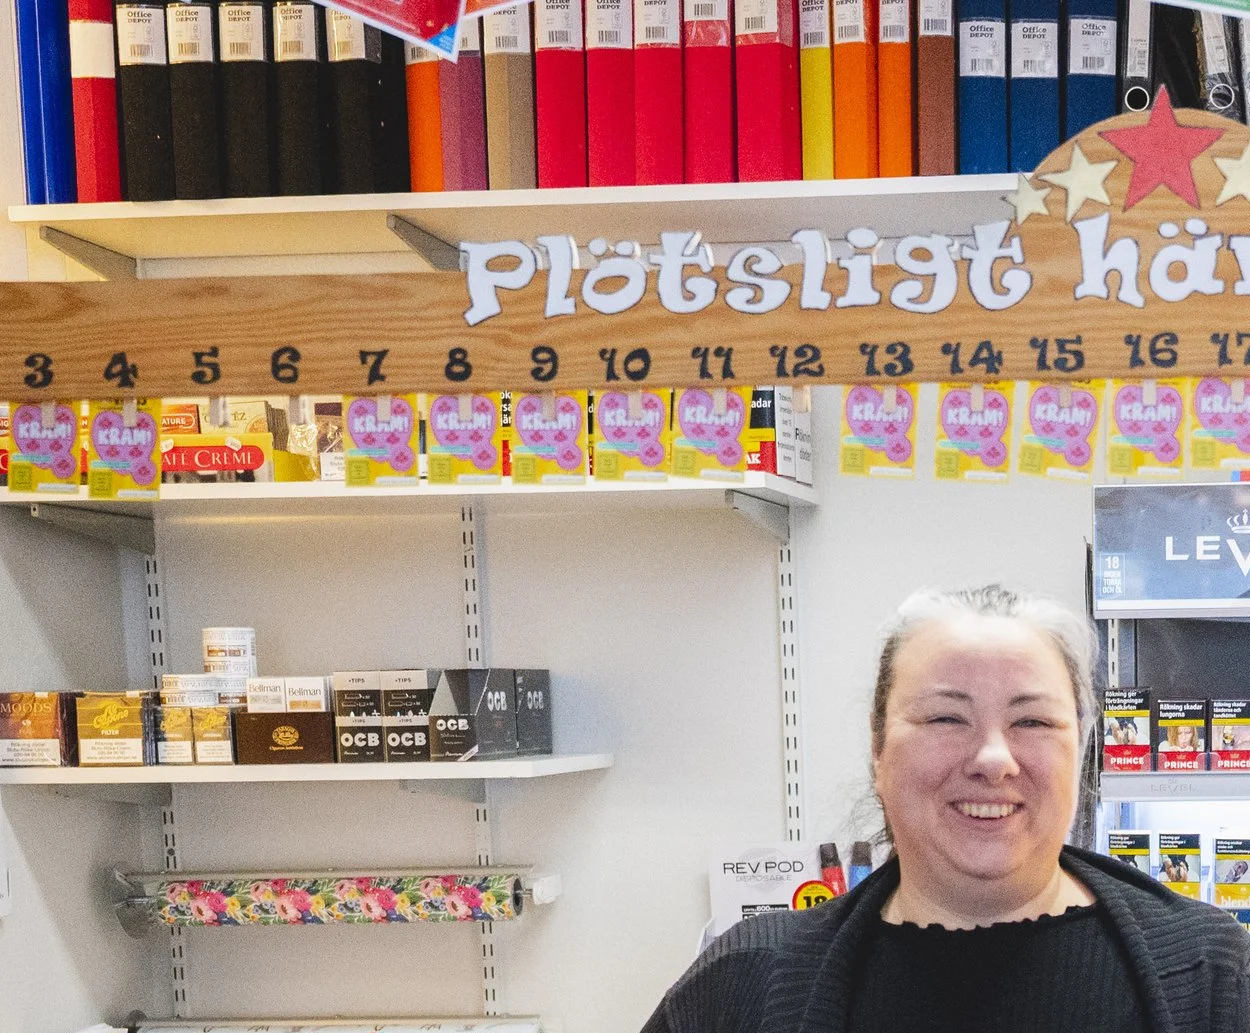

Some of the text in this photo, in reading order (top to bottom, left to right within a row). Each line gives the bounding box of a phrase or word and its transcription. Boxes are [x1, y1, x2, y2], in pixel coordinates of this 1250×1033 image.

[969, 25, 995, 33] Office
[1022, 26, 1047, 34] Office
[1081, 23, 1106, 31] Office
[24, 353, 54, 389] 3
[103, 352, 138, 388] 4
[191, 347, 220, 384] 5
[272, 346, 300, 383] 6
[360, 350, 388, 385] 7
[445, 348, 472, 381] 8
[531, 346, 558, 381] 9
[600, 348, 650, 381] 10
[692, 347, 734, 379] 11
[770, 344, 824, 377] 12
[860, 343, 913, 376] 13
[942, 342, 1002, 374] 14
[1031, 337, 1083, 371] 15
[1126, 333, 1177, 366] 16
[194, 449, 255, 468] CRÈME
[1105, 556, 1120, 569] 18
[249, 683, 282, 693] Bellman
[288, 687, 322, 697] Bellman
[487, 691, 507, 711] OCB
[436, 718, 469, 731] OCB
[341, 733, 380, 748] OCB
[387, 733, 427, 747] OCB
[1110, 756, 1144, 765] PRINCE
[1164, 761, 1198, 769] PRINCE
[723, 861, 804, 874] REV POD
